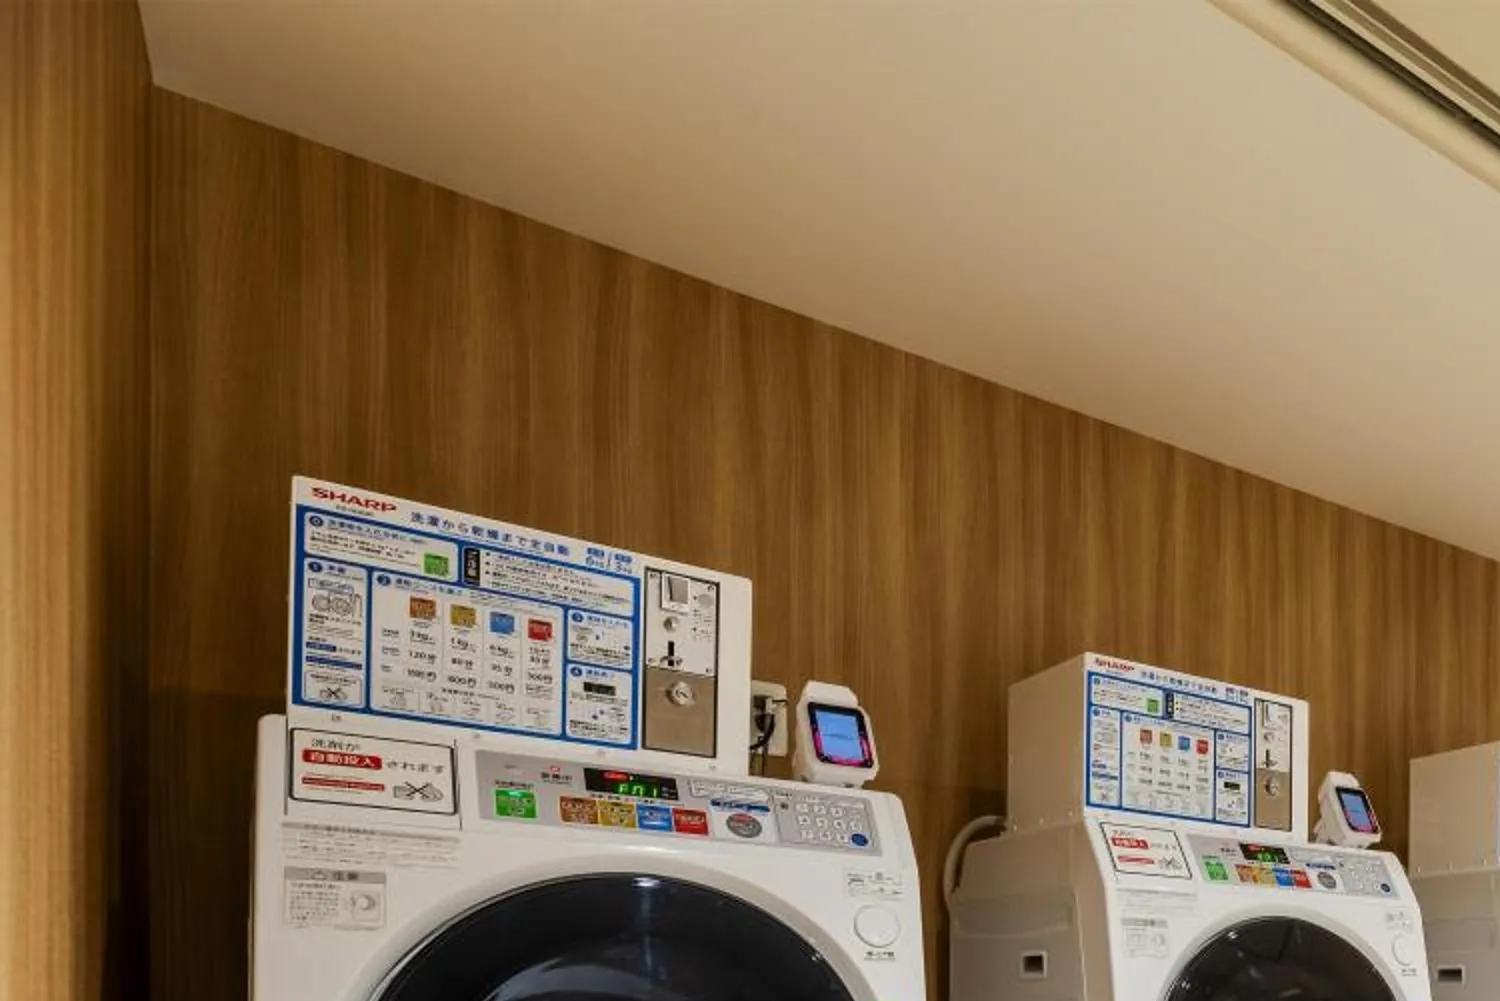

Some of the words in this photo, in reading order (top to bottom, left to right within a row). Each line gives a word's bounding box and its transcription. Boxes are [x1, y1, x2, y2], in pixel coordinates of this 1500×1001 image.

[312, 487, 397, 512] SHARP
[310, 752, 375, 767] 自動投入
[386, 761, 444, 774] されます
